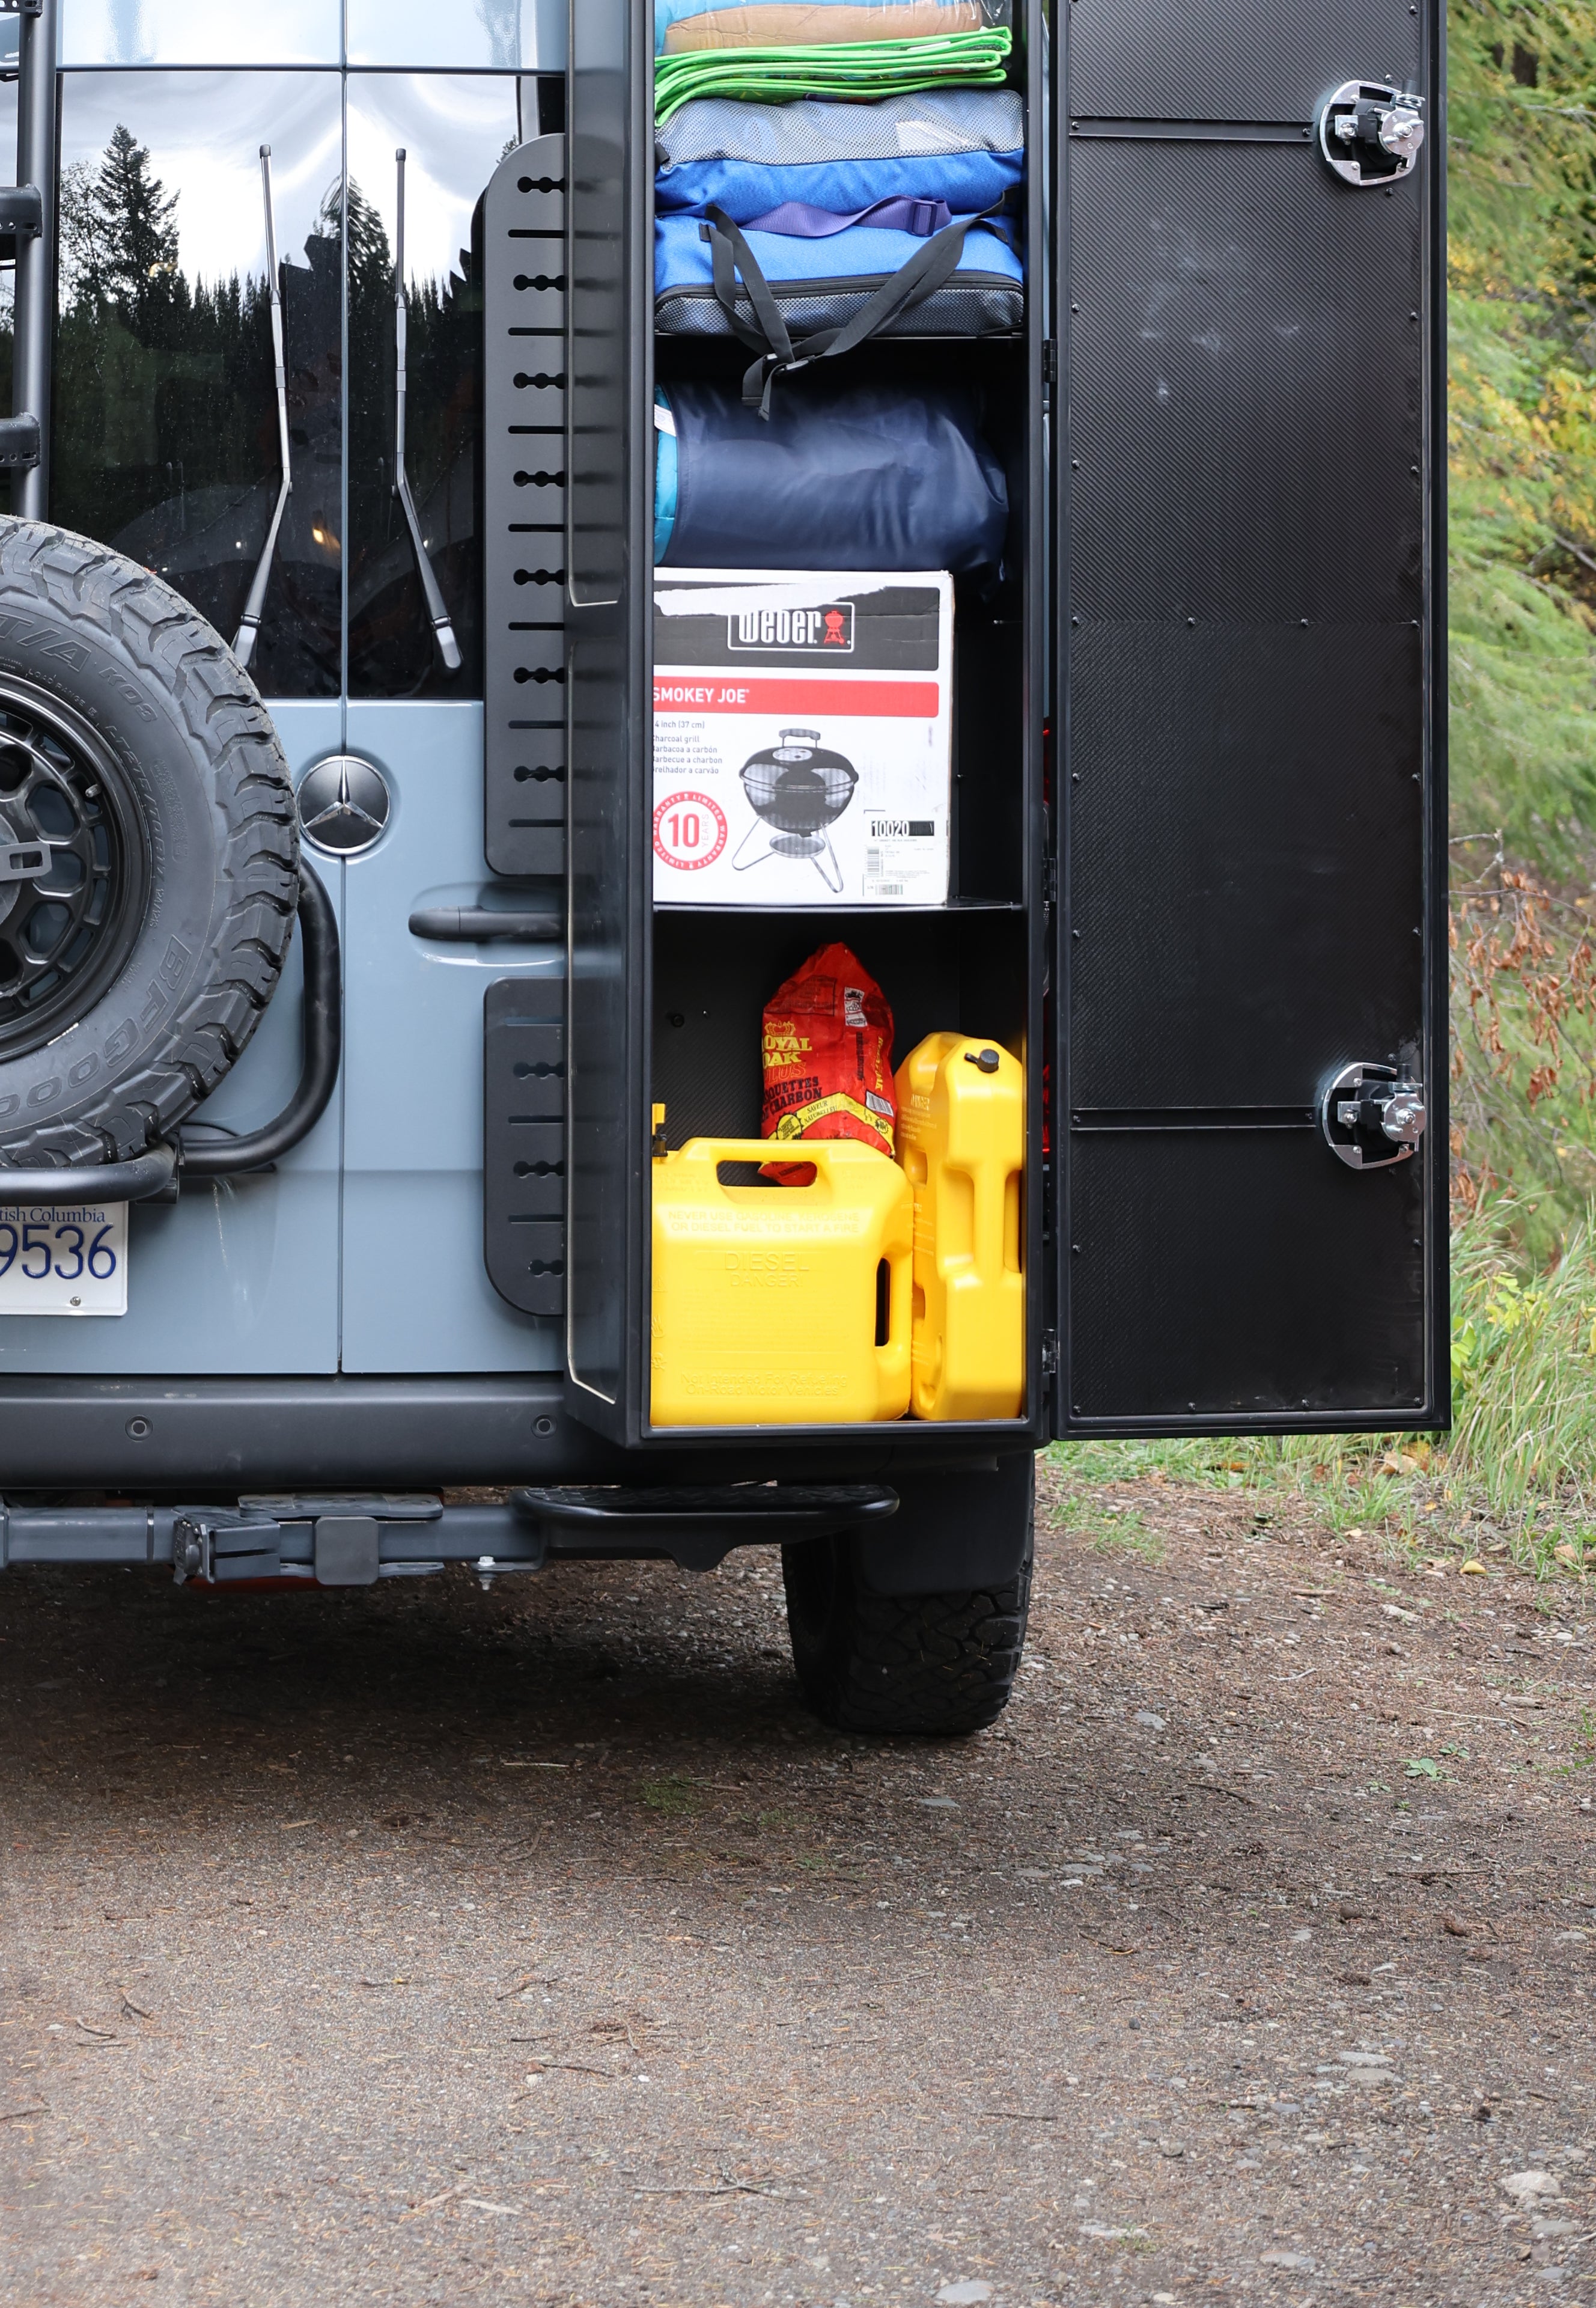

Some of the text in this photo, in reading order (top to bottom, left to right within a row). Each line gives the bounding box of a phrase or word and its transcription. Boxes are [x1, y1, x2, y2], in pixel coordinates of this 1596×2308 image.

[28, 668, 54, 685] LOAD
[55, 683, 86, 706] RANGE
[99, 666, 158, 721] KO3
[653, 687, 714, 703] SMOKEY
[692, 721, 705, 729] cm)
[668, 813, 699, 847] 10
[871, 820, 910, 836] 10020
[762, 1034, 812, 1051] OYAL
[766, 1061, 806, 1084] LUS
[30, 1207, 105, 1222] Columbia
[668, 1211, 707, 1220] NEVER
[710, 1211, 733, 1220] USE
[671, 1222, 859, 1233] OR DIESEL FUEL TO START A FIRE
[0, 1223, 117, 1280] 9536
[725, 1251, 810, 1271] DIESEL
[730, 1272, 803, 1287] DANGER!
[681, 1372, 848, 1387] Not Intended For Refueling
[685, 1384, 840, 1396] On-Road Motor Vehicles
